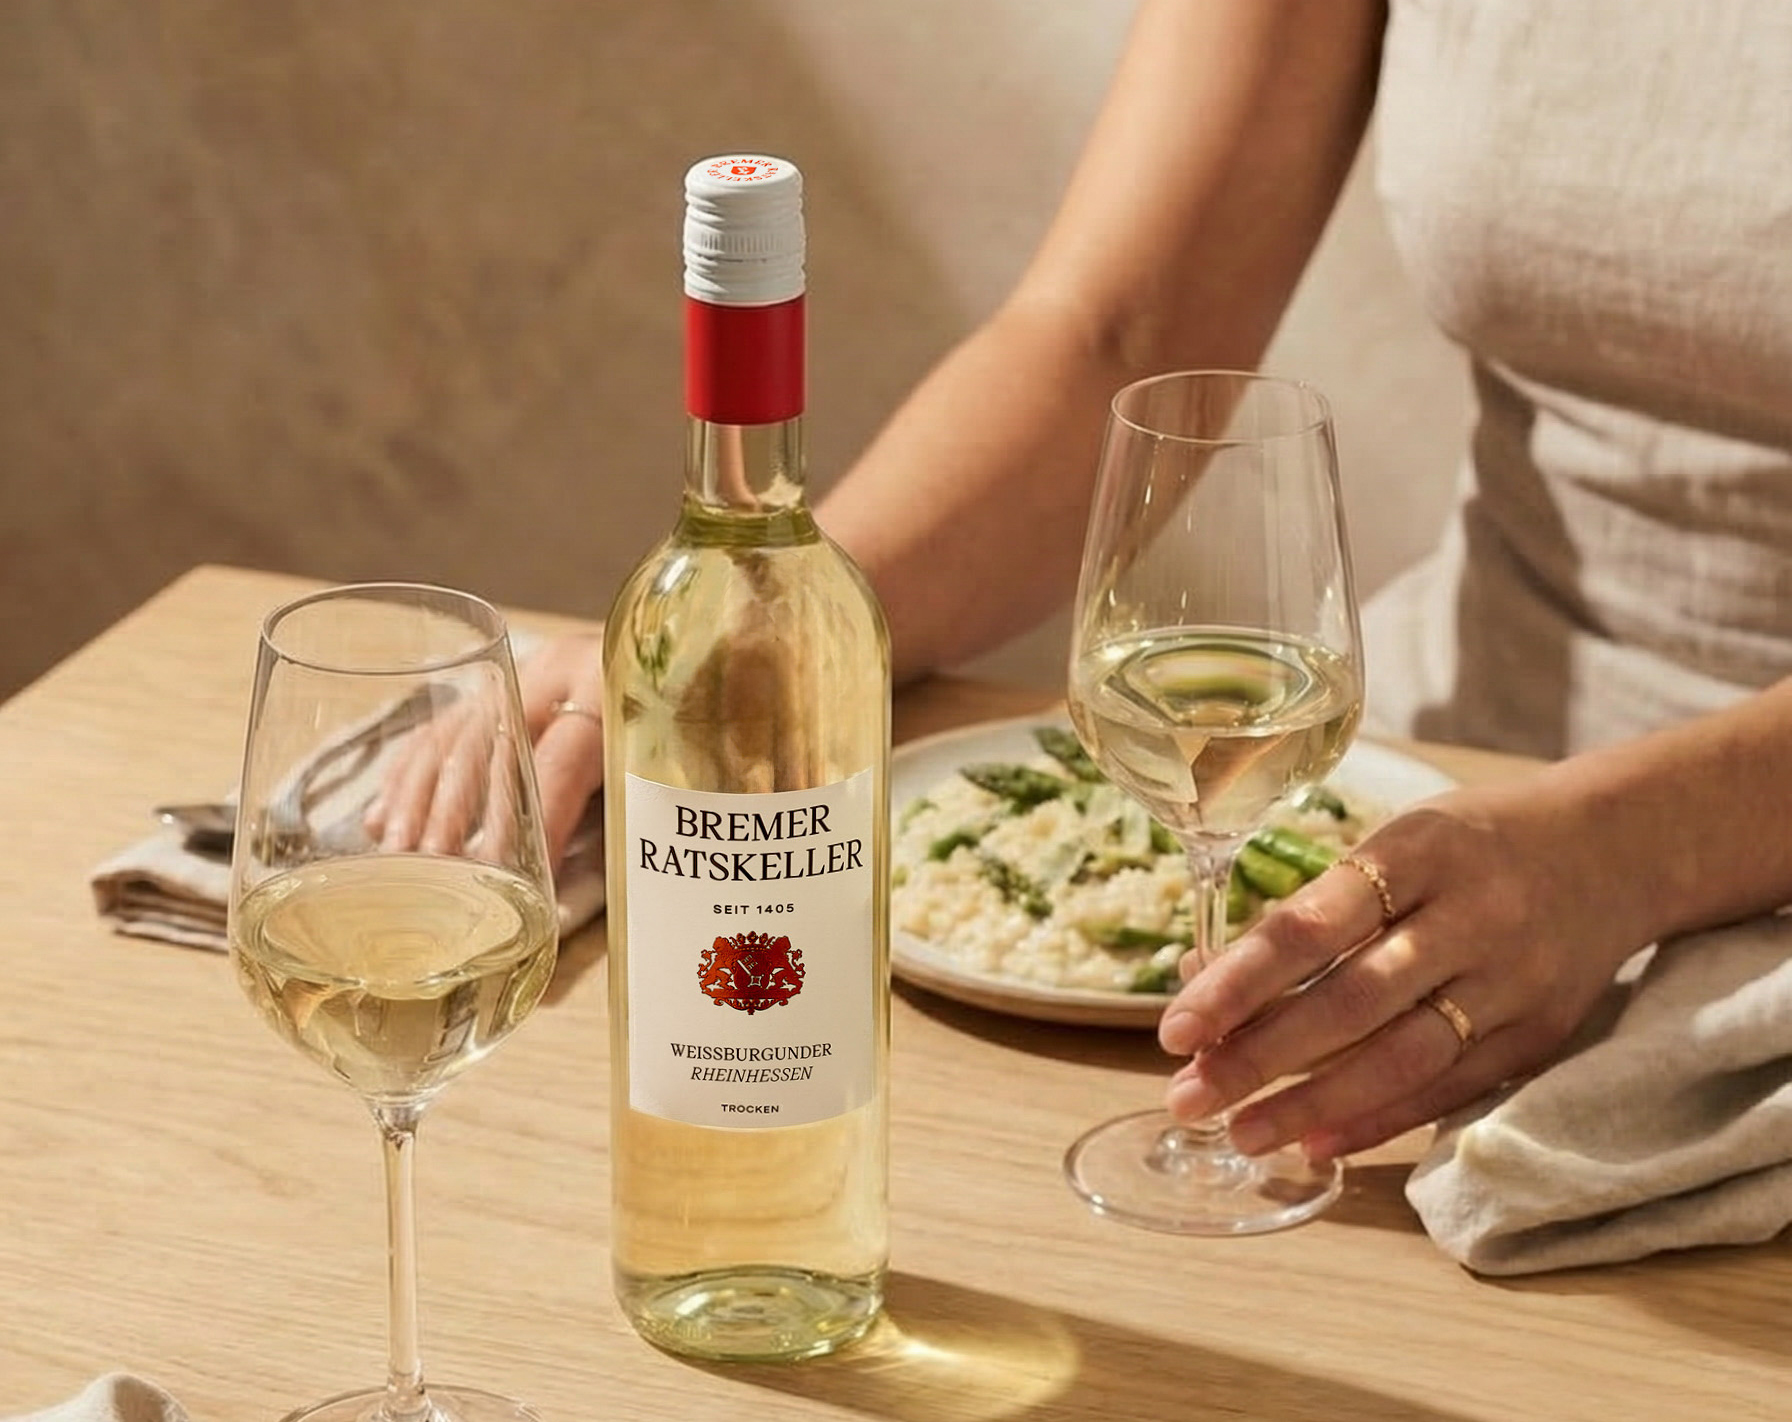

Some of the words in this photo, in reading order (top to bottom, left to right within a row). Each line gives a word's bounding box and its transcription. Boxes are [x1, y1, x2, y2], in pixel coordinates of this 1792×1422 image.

[675, 804, 832, 842] BREMER
[639, 837, 864, 882] RATSKELLER
[713, 904, 750, 915] SEIT
[756, 903, 795, 915] 1405
[670, 1042, 833, 1062] WEISSBURGUNDER
[690, 1065, 814, 1083] RHEINHESSEN
[720, 1103, 780, 1114] TROCKEN
